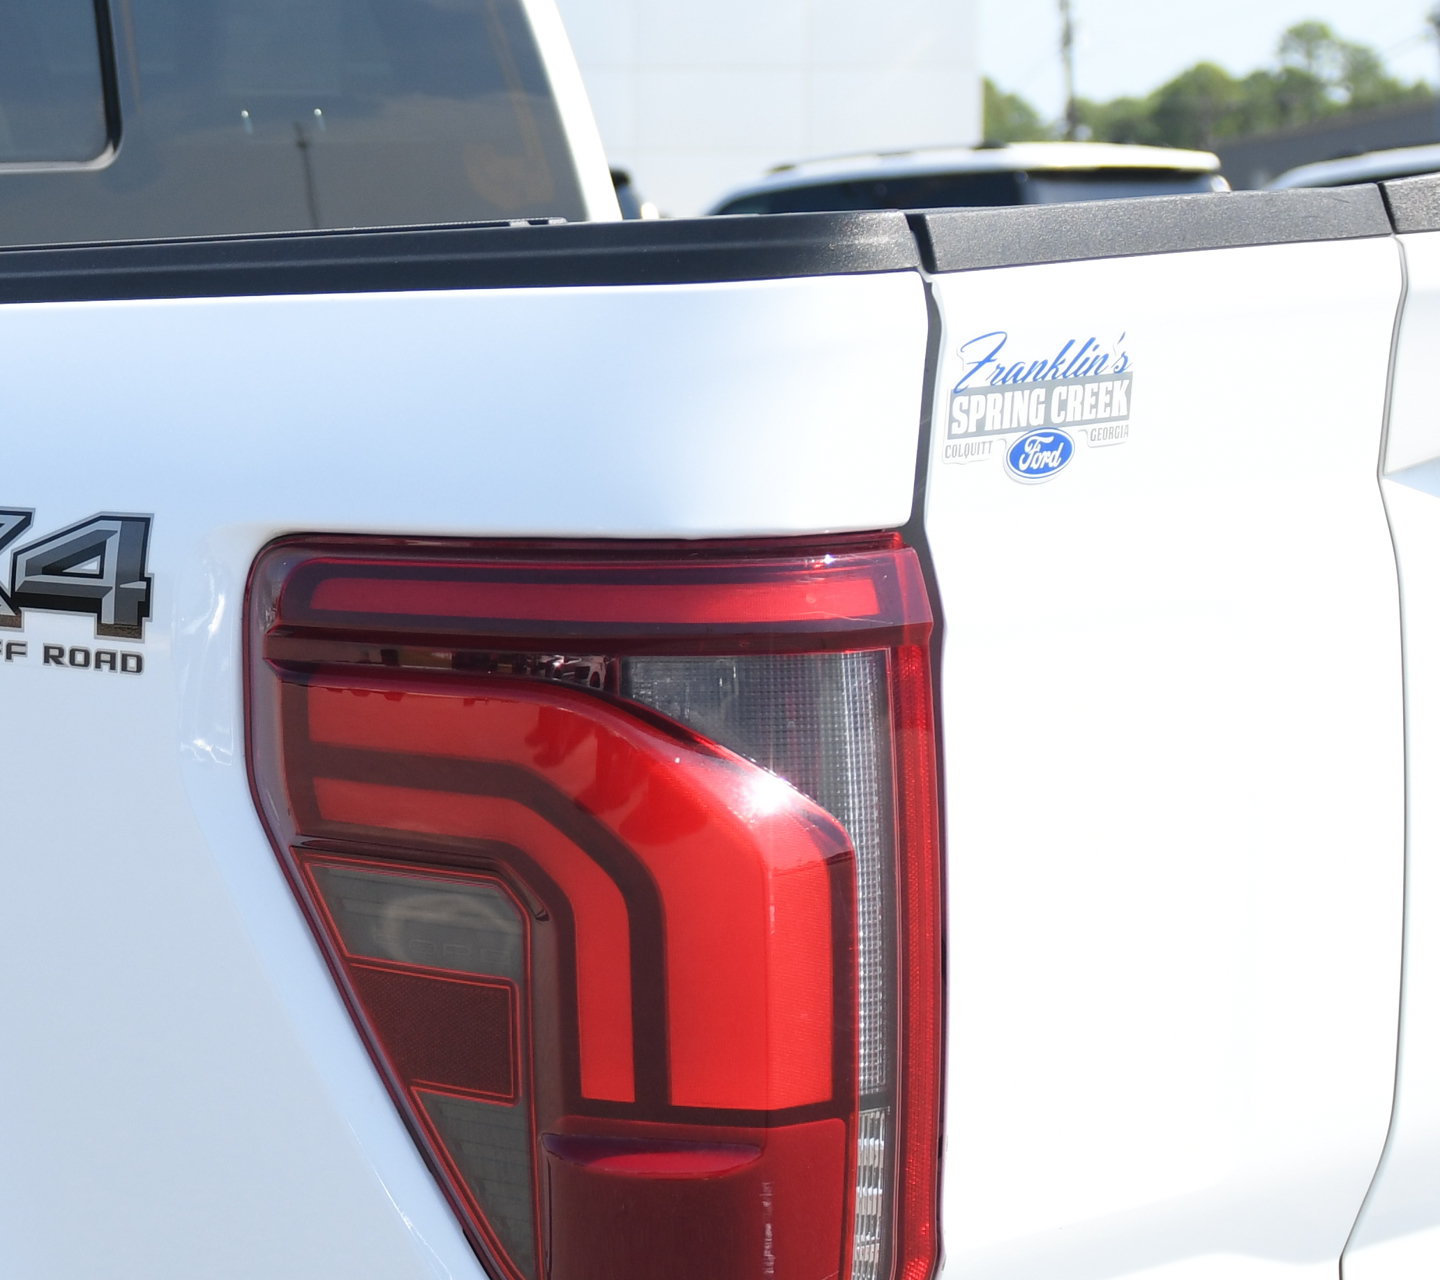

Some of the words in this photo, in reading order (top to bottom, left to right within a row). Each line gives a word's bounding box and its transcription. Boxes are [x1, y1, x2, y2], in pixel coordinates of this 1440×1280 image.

[952, 330, 1133, 394] Franklin's
[950, 387, 1047, 436] SPRING
[1051, 378, 1131, 424] CREEK
[944, 439, 994, 459] COLQUITT
[1089, 423, 1130, 442] GEORGIA
[1017, 434, 1065, 471] Ford
[42, 642, 146, 676] ROAD
